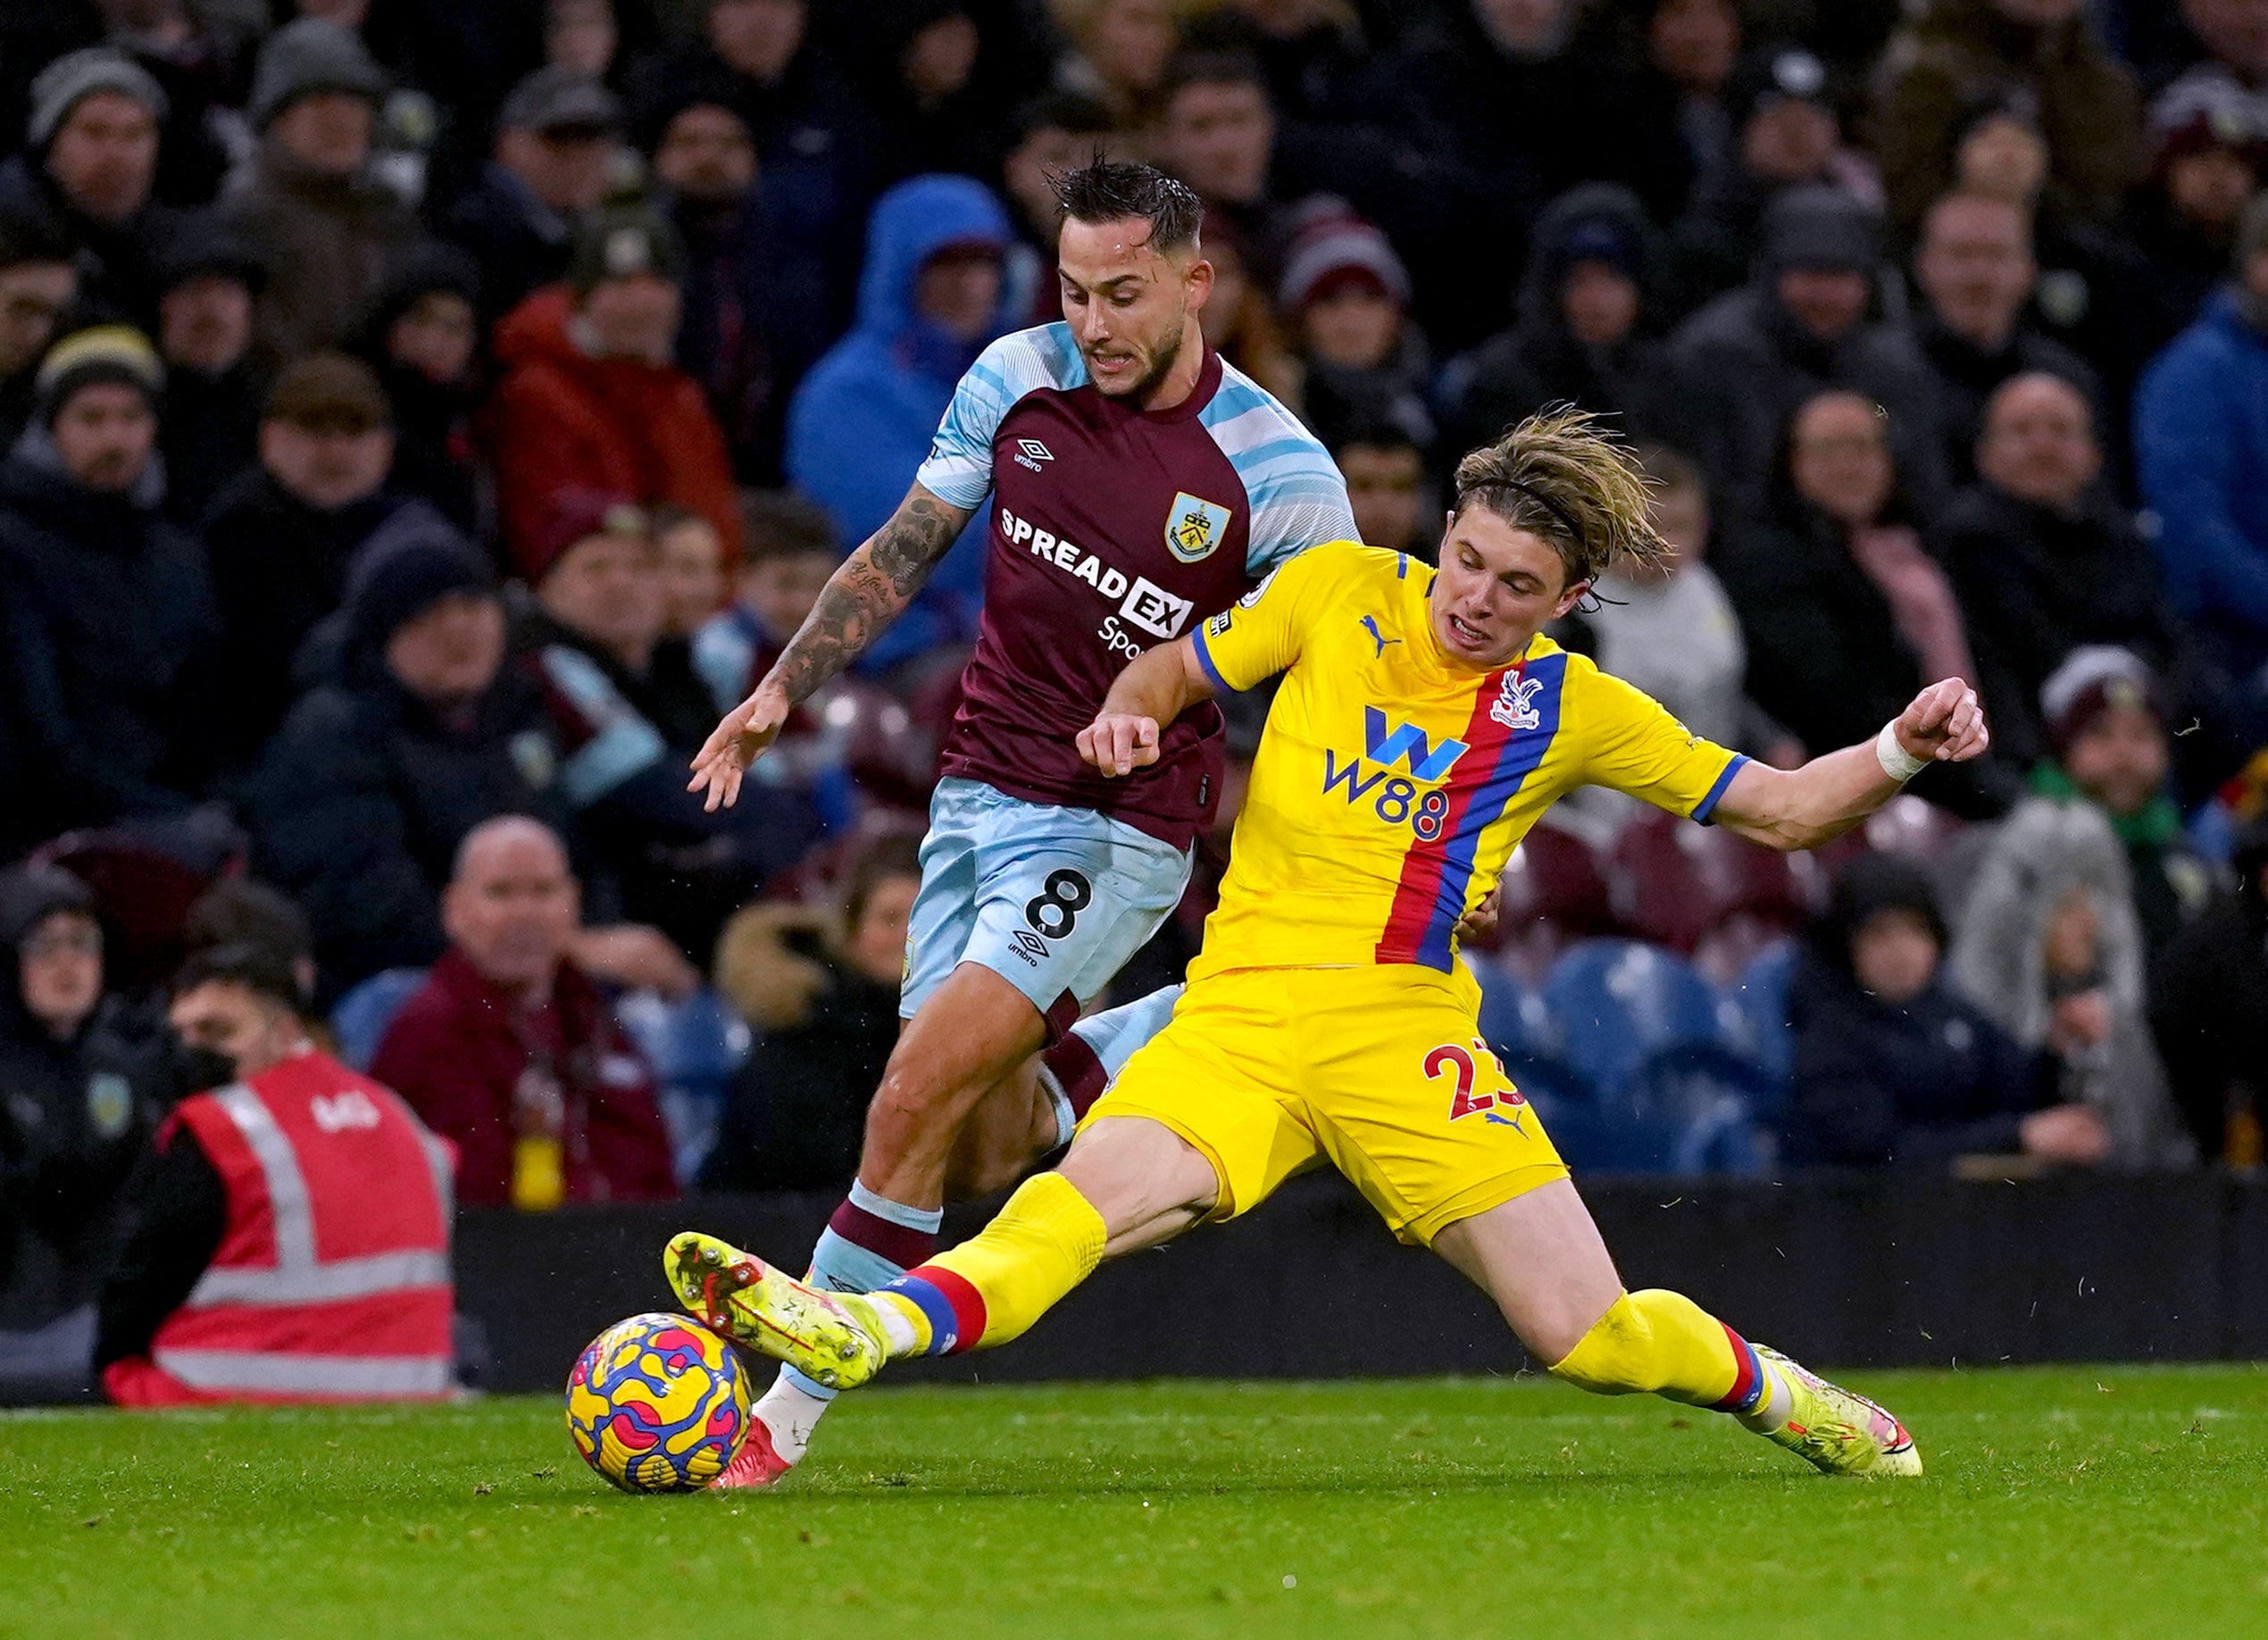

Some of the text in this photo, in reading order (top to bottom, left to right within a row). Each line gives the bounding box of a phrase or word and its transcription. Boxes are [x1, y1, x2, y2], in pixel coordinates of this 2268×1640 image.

[1013, 453, 1043, 472] umbro
[1001, 507, 1182, 632] SPREADEX
[1097, 616, 1146, 661] Spo
[1322, 748, 1449, 842] W88
[1024, 867, 1092, 941] 8
[1007, 943, 1038, 967] umbro
